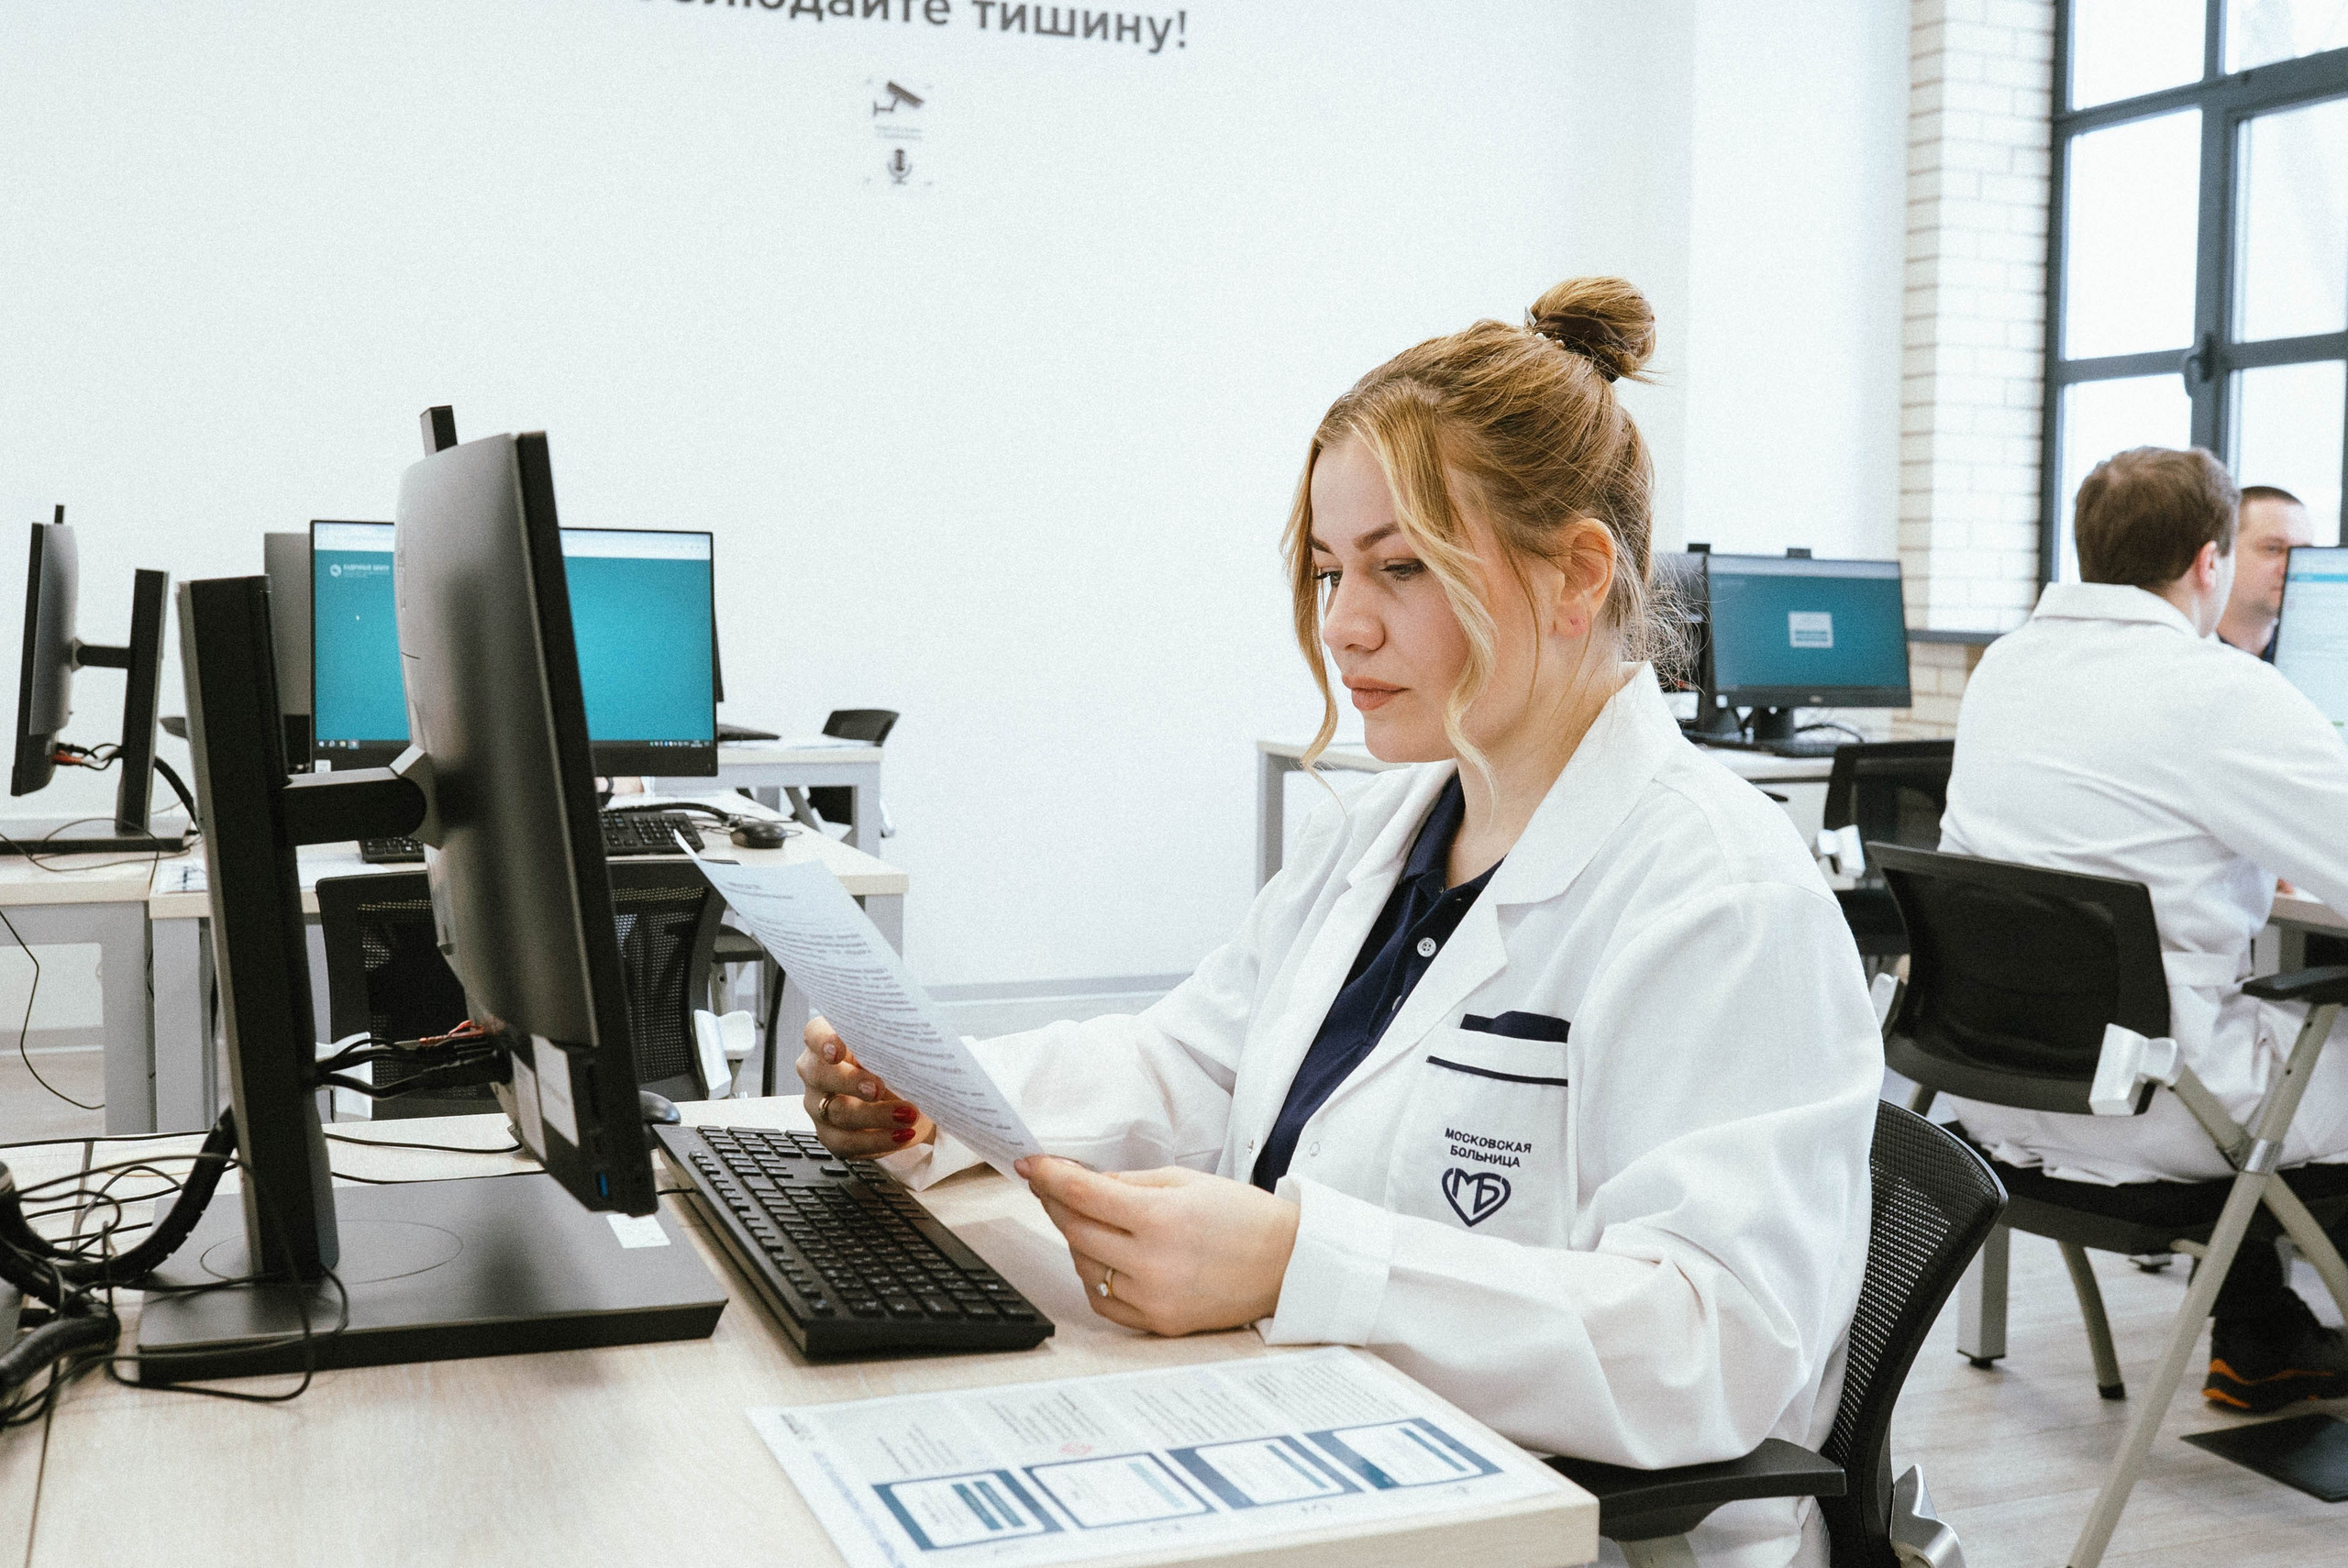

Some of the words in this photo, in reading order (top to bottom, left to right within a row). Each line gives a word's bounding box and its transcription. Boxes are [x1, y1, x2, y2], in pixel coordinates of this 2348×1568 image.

[971, 0, 1187, 55] тишину!
[1445, 1127, 1533, 1154] МОСКОВСКАЯ
[1449, 1144, 1521, 1168] БОЛЬНИЦА
